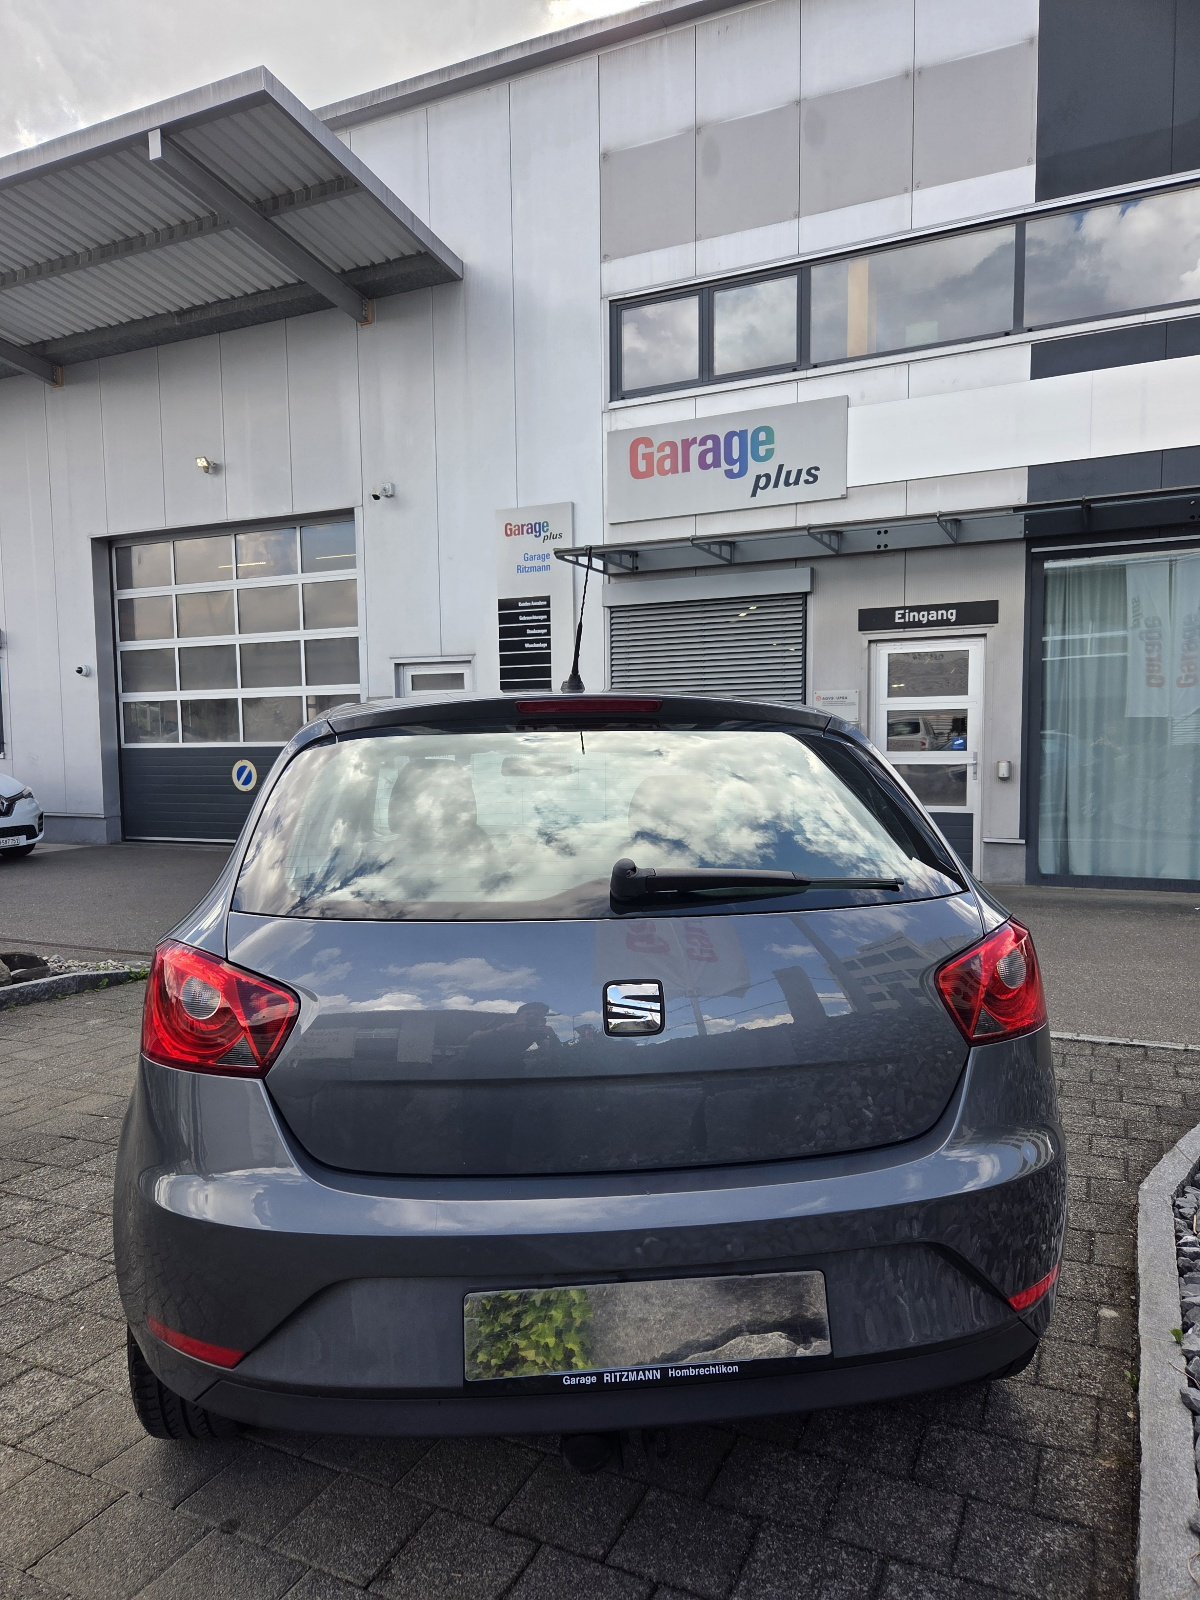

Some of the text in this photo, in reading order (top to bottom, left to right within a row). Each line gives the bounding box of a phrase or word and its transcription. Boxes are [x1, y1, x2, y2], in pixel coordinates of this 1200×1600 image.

[629, 425, 775, 480] Garage
[750, 463, 821, 498] plus
[505, 520, 550, 538] Garage
[542, 531, 563, 543] plus
[524, 552, 550, 562] Garage
[517, 563, 551, 573] Ritzmann
[894, 609, 957, 623] Eingang
[562, 1364, 739, 1386] Garage RITZMANN Hombrechtikon
